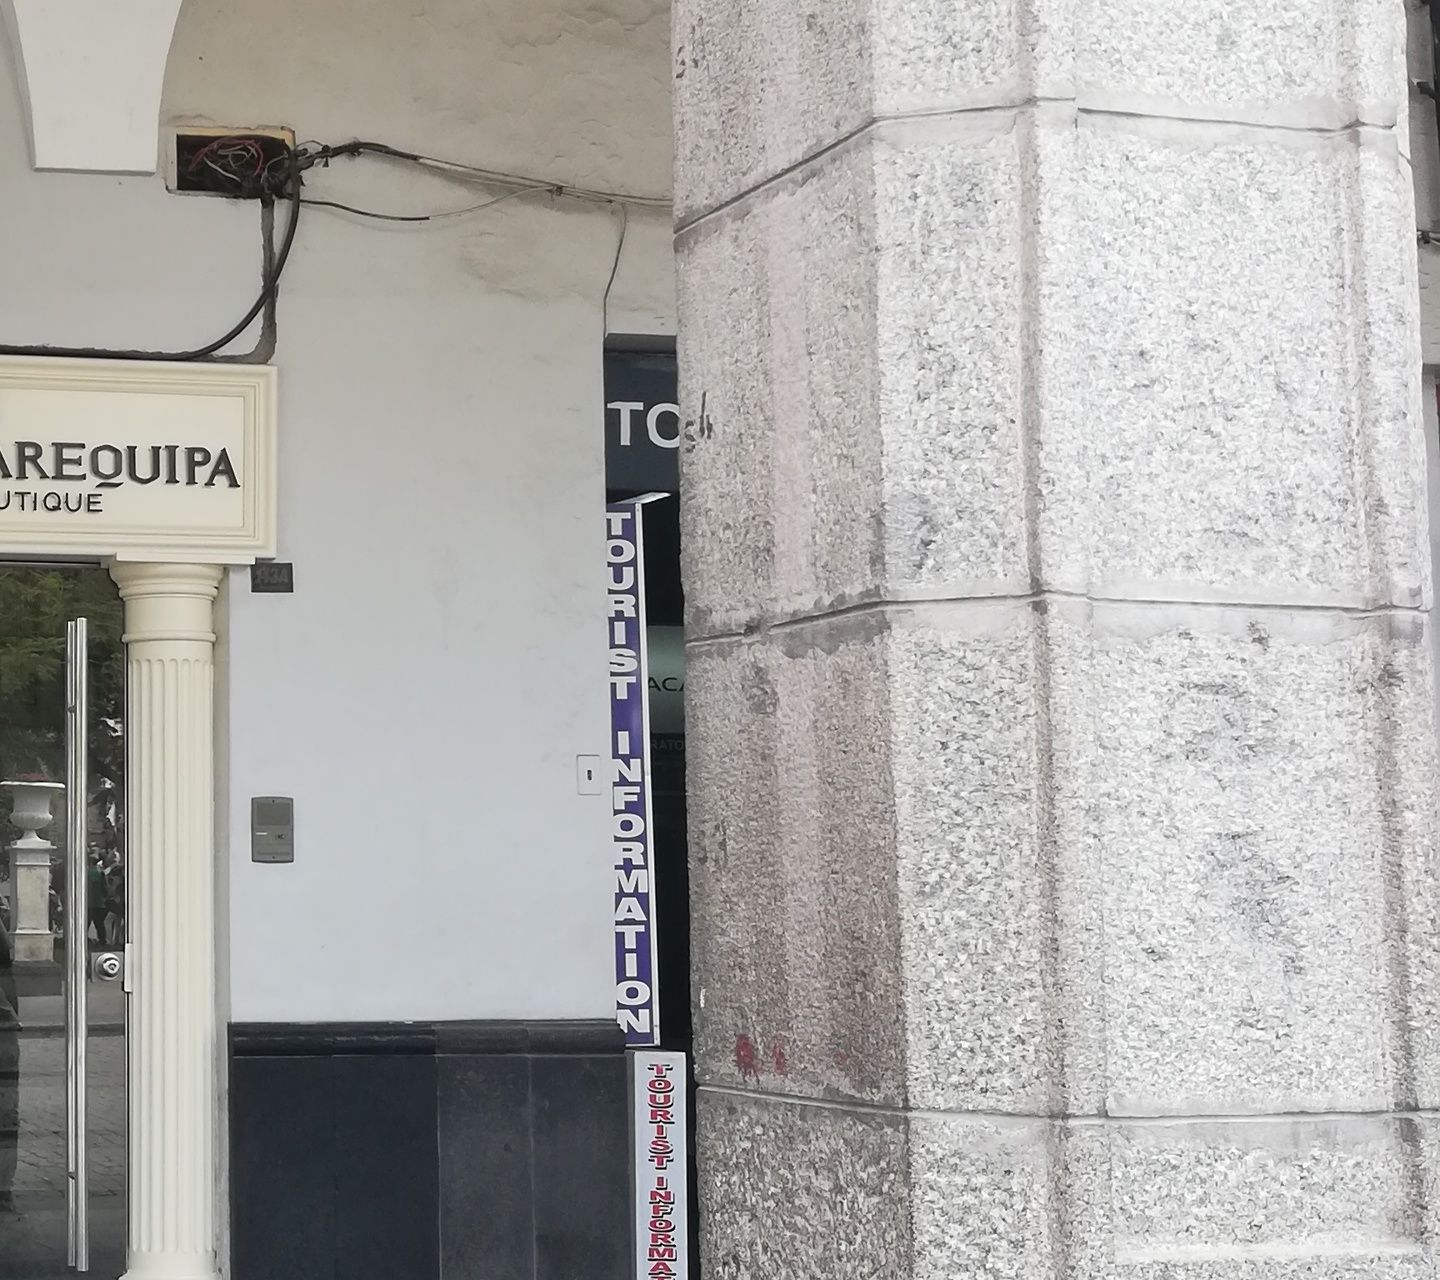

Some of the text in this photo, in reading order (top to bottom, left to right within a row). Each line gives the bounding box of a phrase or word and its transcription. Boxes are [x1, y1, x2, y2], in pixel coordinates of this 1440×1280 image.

[648, 676, 684, 692] AC
[606, 511, 651, 1034] TOURIST INFORMATION
[647, 1063, 675, 1170] TOURIST
